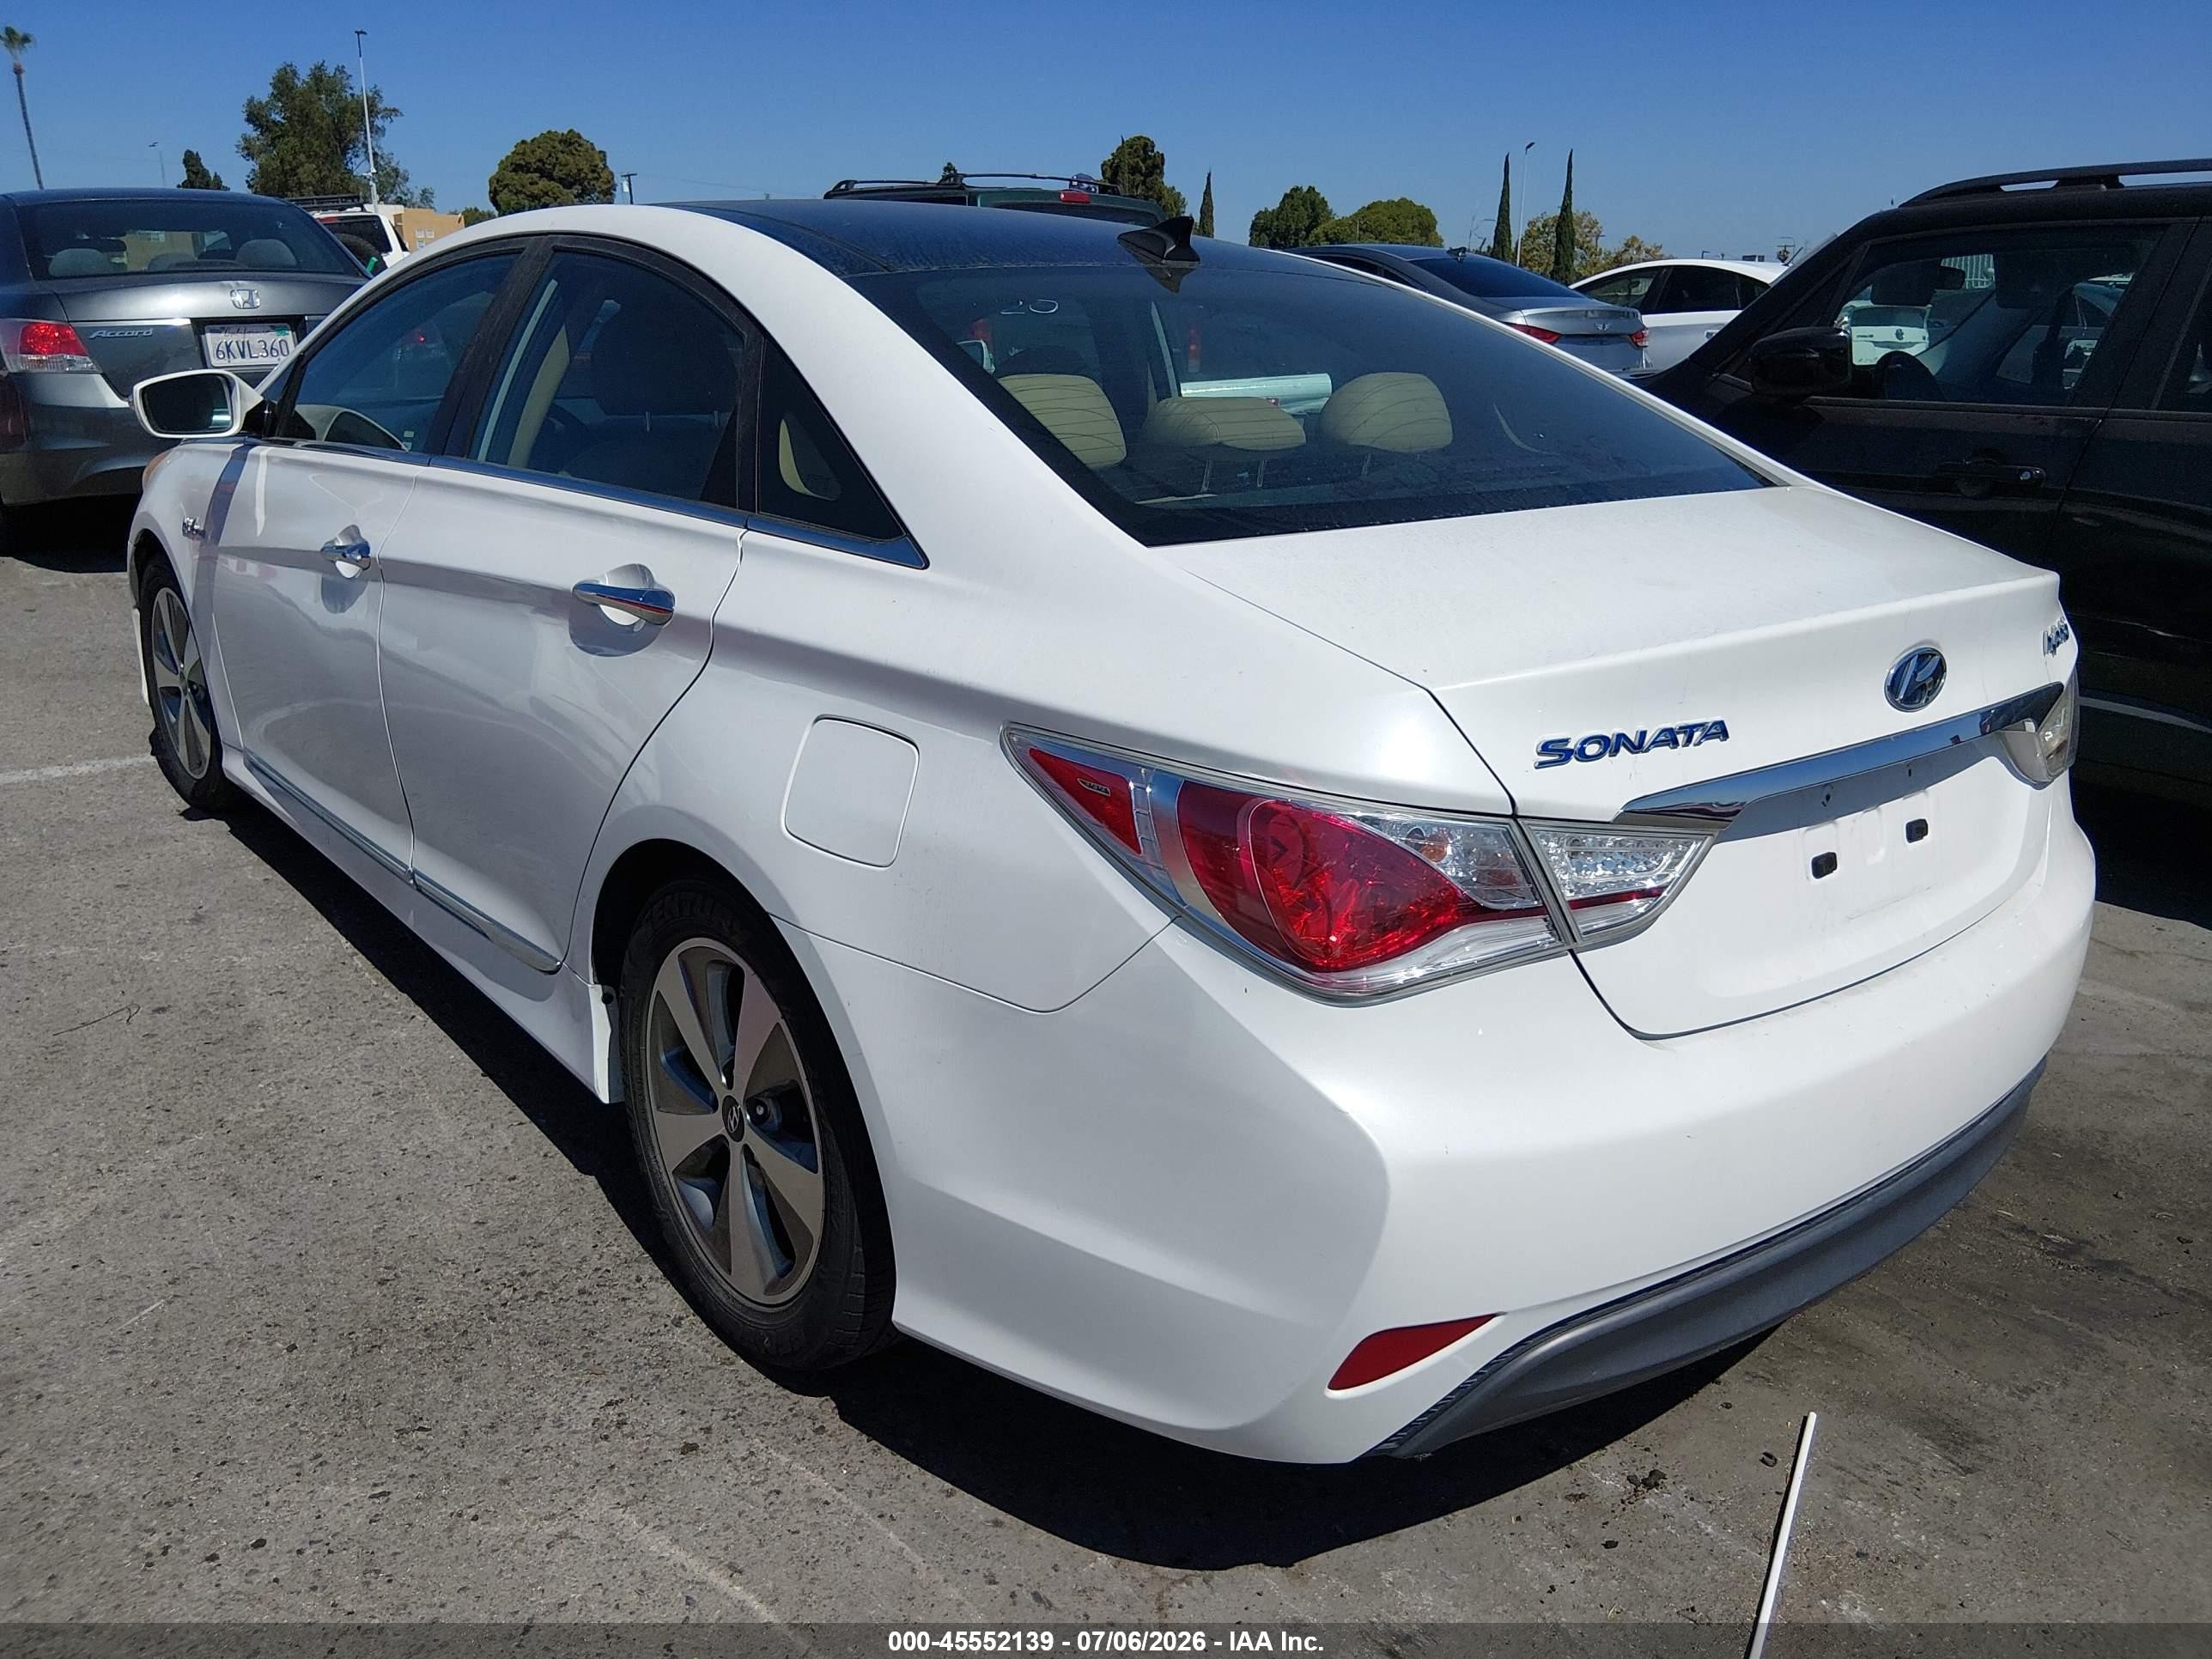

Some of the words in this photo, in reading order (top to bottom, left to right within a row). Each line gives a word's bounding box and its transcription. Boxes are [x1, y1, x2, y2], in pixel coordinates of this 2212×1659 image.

[89, 327, 154, 339] Accord
[216, 338, 290, 359] 6KVL360
[1534, 719, 1730, 769] SONATA
